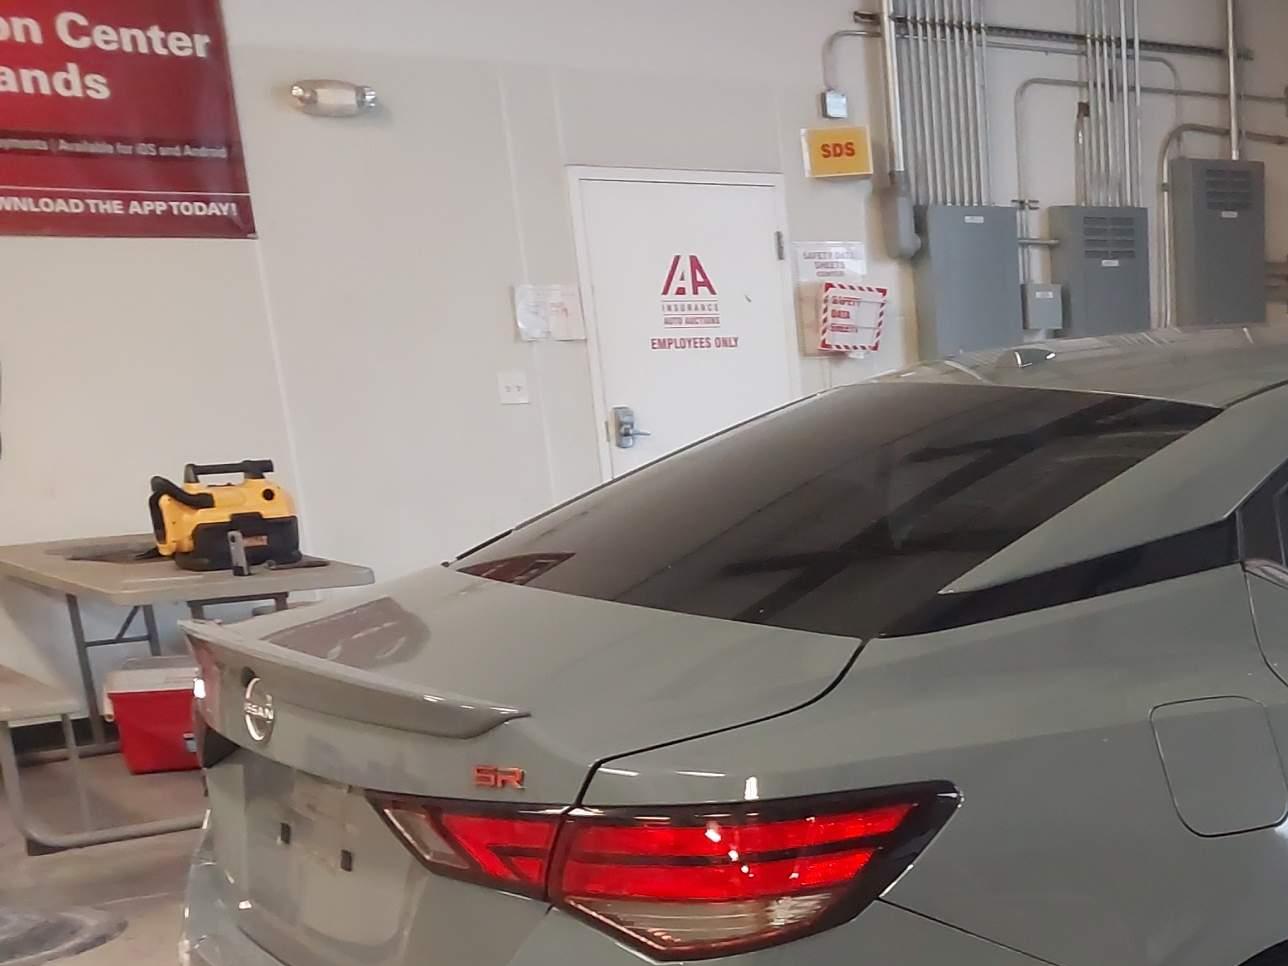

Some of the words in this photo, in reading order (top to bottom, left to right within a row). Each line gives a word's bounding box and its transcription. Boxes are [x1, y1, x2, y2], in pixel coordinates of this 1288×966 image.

[55, 11, 211, 58] Center
[0, 62, 111, 100] ands
[820, 142, 855, 159] SDS
[84, 199, 124, 214] THE
[128, 201, 167, 215] APP
[168, 201, 238, 216] TODAY!
[650, 337, 712, 350] EMPLOYEES
[714, 336, 739, 348] ONLY
[474, 765, 526, 791] SR
